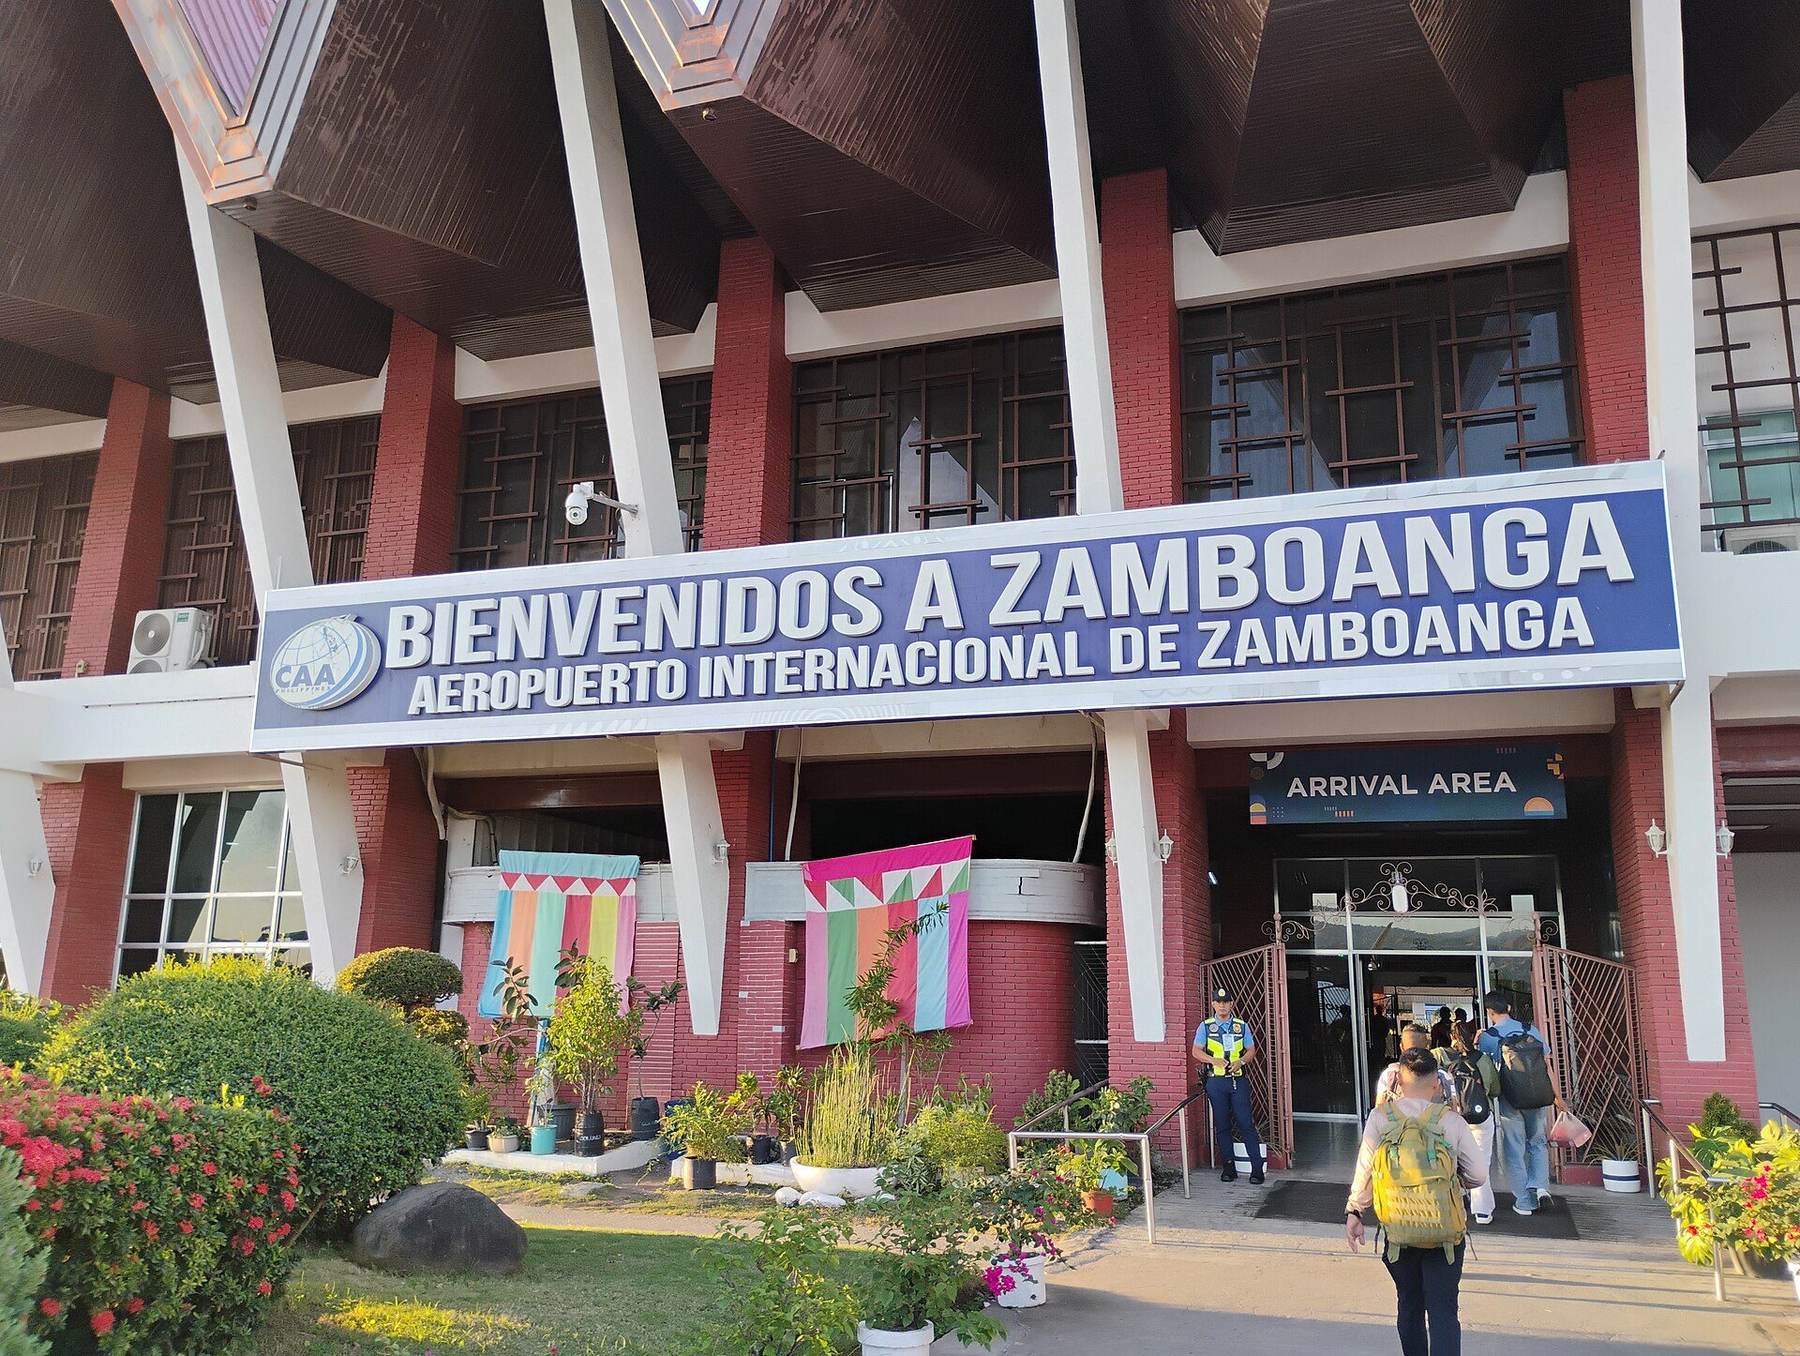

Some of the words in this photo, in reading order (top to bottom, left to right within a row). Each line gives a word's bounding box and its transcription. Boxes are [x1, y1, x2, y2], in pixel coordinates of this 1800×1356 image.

[385, 566, 883, 668] BIENVENIDOS
[904, 559, 965, 632] A
[989, 500, 1635, 628] ZAMBOANGA
[275, 663, 336, 688] CAA
[408, 658, 686, 715] AEROPUERTO
[698, 630, 1095, 698] INTERNACIONAL
[1109, 623, 1181, 674] DE
[1197, 597, 1595, 668] ZAMBOANGA
[1286, 774, 1418, 798] ARRIVAL
[1427, 771, 1518, 794] AREA
